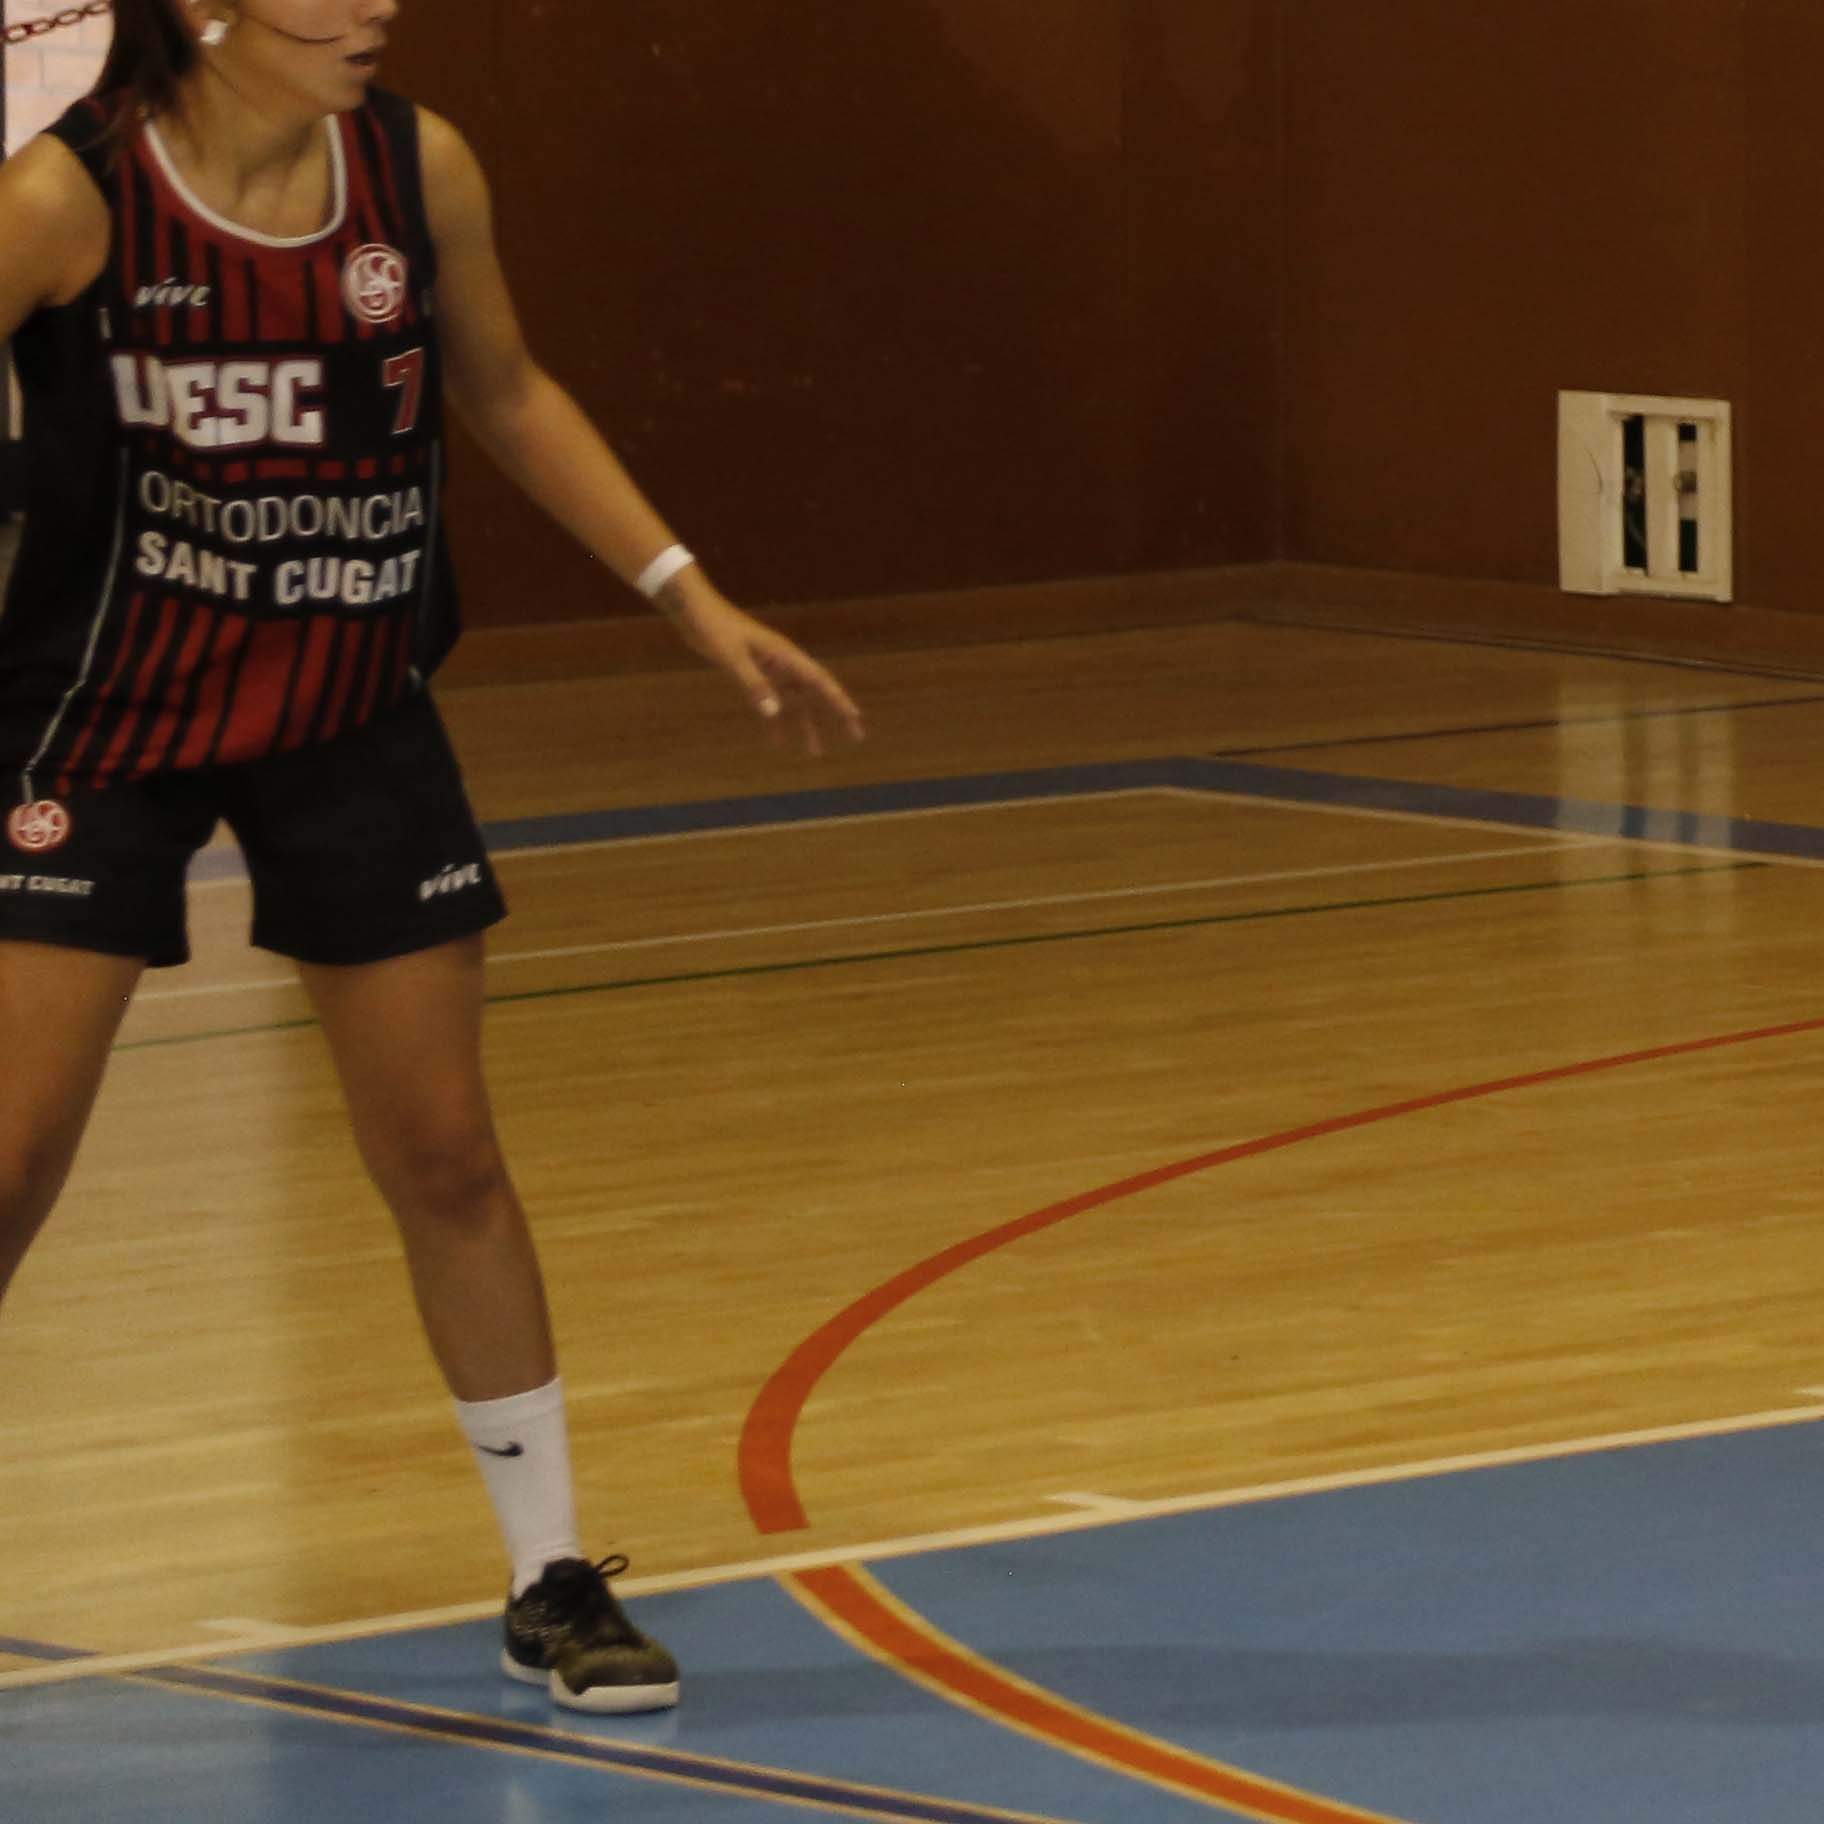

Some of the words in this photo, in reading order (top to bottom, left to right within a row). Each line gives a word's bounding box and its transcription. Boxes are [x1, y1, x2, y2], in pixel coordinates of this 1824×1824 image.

[110, 351, 326, 449] UESC
[382, 346, 425, 435] 7
[139, 470, 425, 543] ORTODONCIA
[136, 530, 257, 600] SANT
[273, 549, 422, 606] CUGAT
